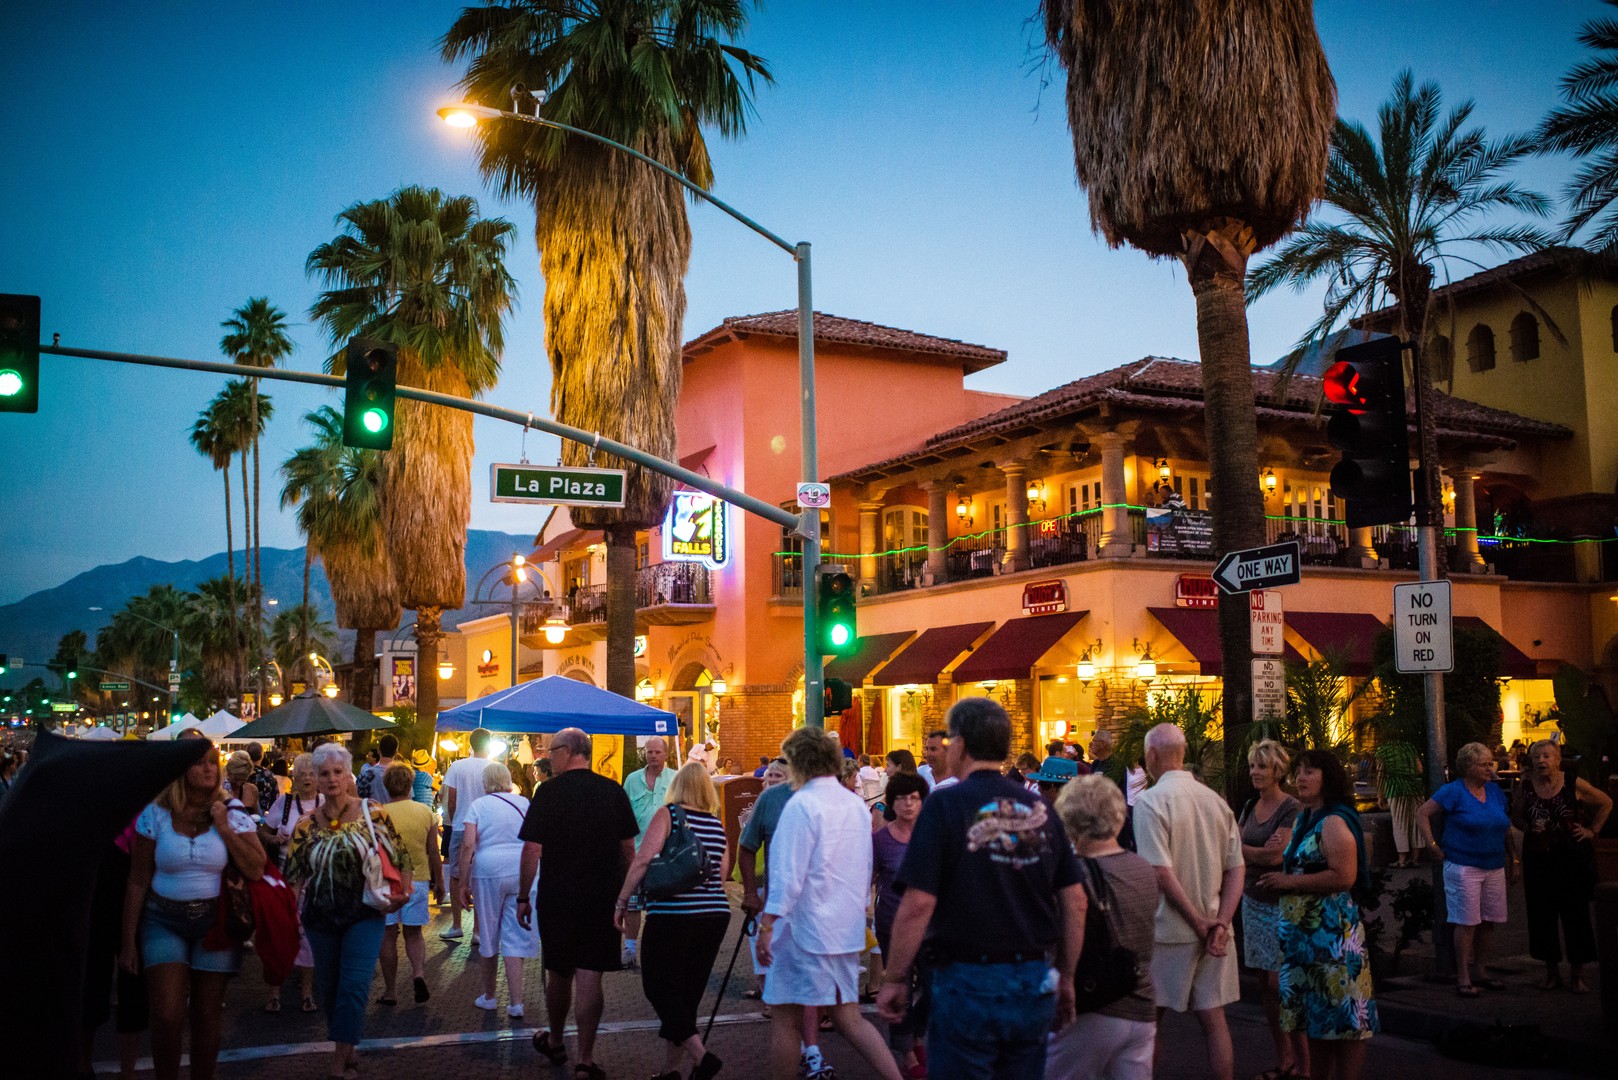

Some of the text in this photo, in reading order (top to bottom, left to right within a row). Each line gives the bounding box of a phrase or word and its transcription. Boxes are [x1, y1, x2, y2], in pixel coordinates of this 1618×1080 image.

[515, 474, 606, 496] La Plaza
[1041, 520, 1057, 532] OPE
[673, 541, 711, 554] FALLS
[1237, 556, 1289, 580] ONE WAY
[1252, 594, 1263, 608] NO
[1411, 592, 1433, 609] NO
[1031, 604, 1056, 613] DINER
[1252, 611, 1281, 624] PARKING
[1408, 613, 1437, 627] TURN
[1261, 625, 1273, 635] ANY
[1261, 636, 1275, 646] TIME
[1415, 631, 1431, 644] ON
[1413, 649, 1435, 662] RED
[1263, 663, 1273, 671] NO
